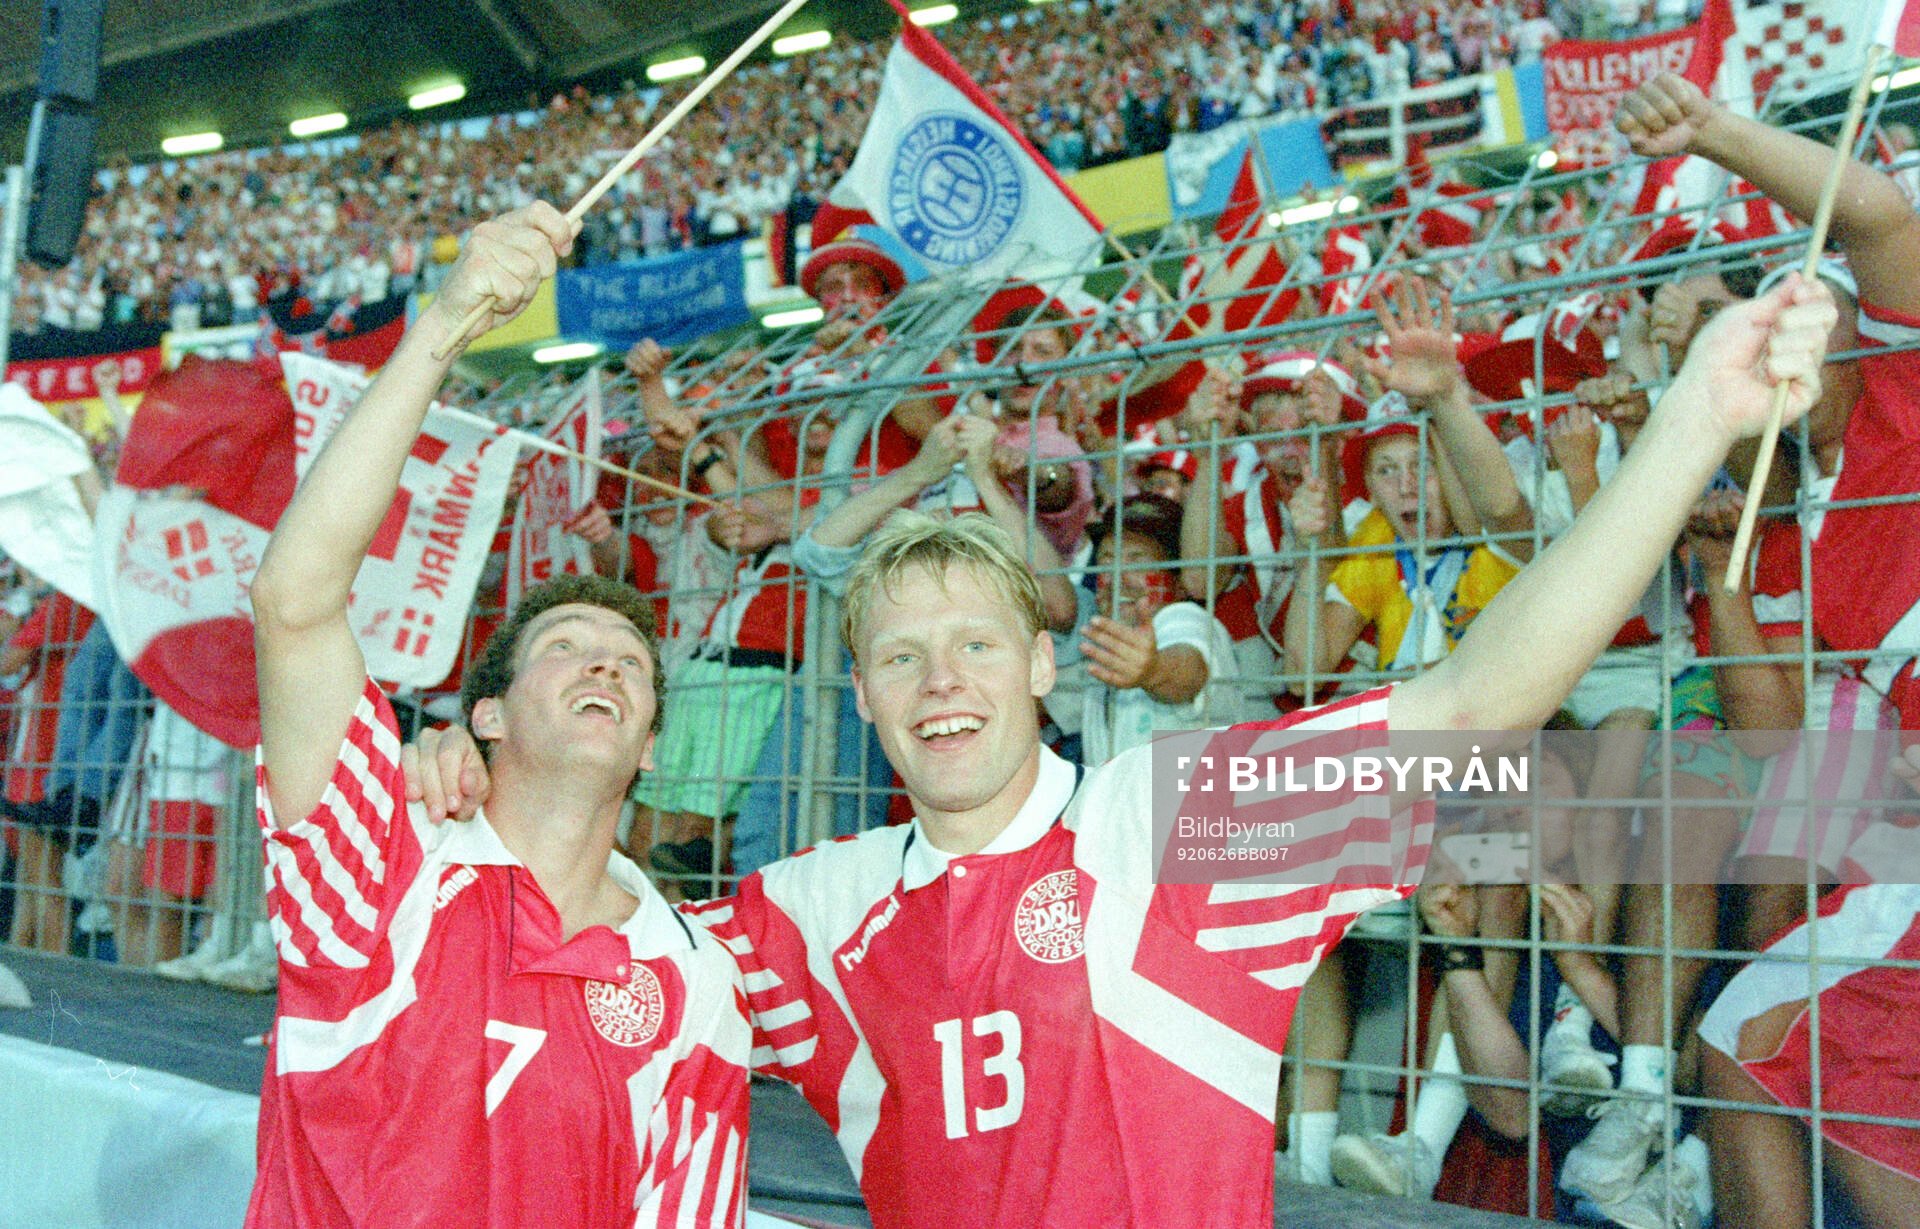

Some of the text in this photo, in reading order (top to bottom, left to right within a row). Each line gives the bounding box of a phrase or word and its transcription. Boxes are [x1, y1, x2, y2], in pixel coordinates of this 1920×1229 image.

[432, 865, 479, 913] ummel
[1032, 900, 1081, 934] DBU
[599, 981, 647, 1024] DBU
[484, 1020, 547, 1118] 7
[933, 1010, 1025, 1139] 13
